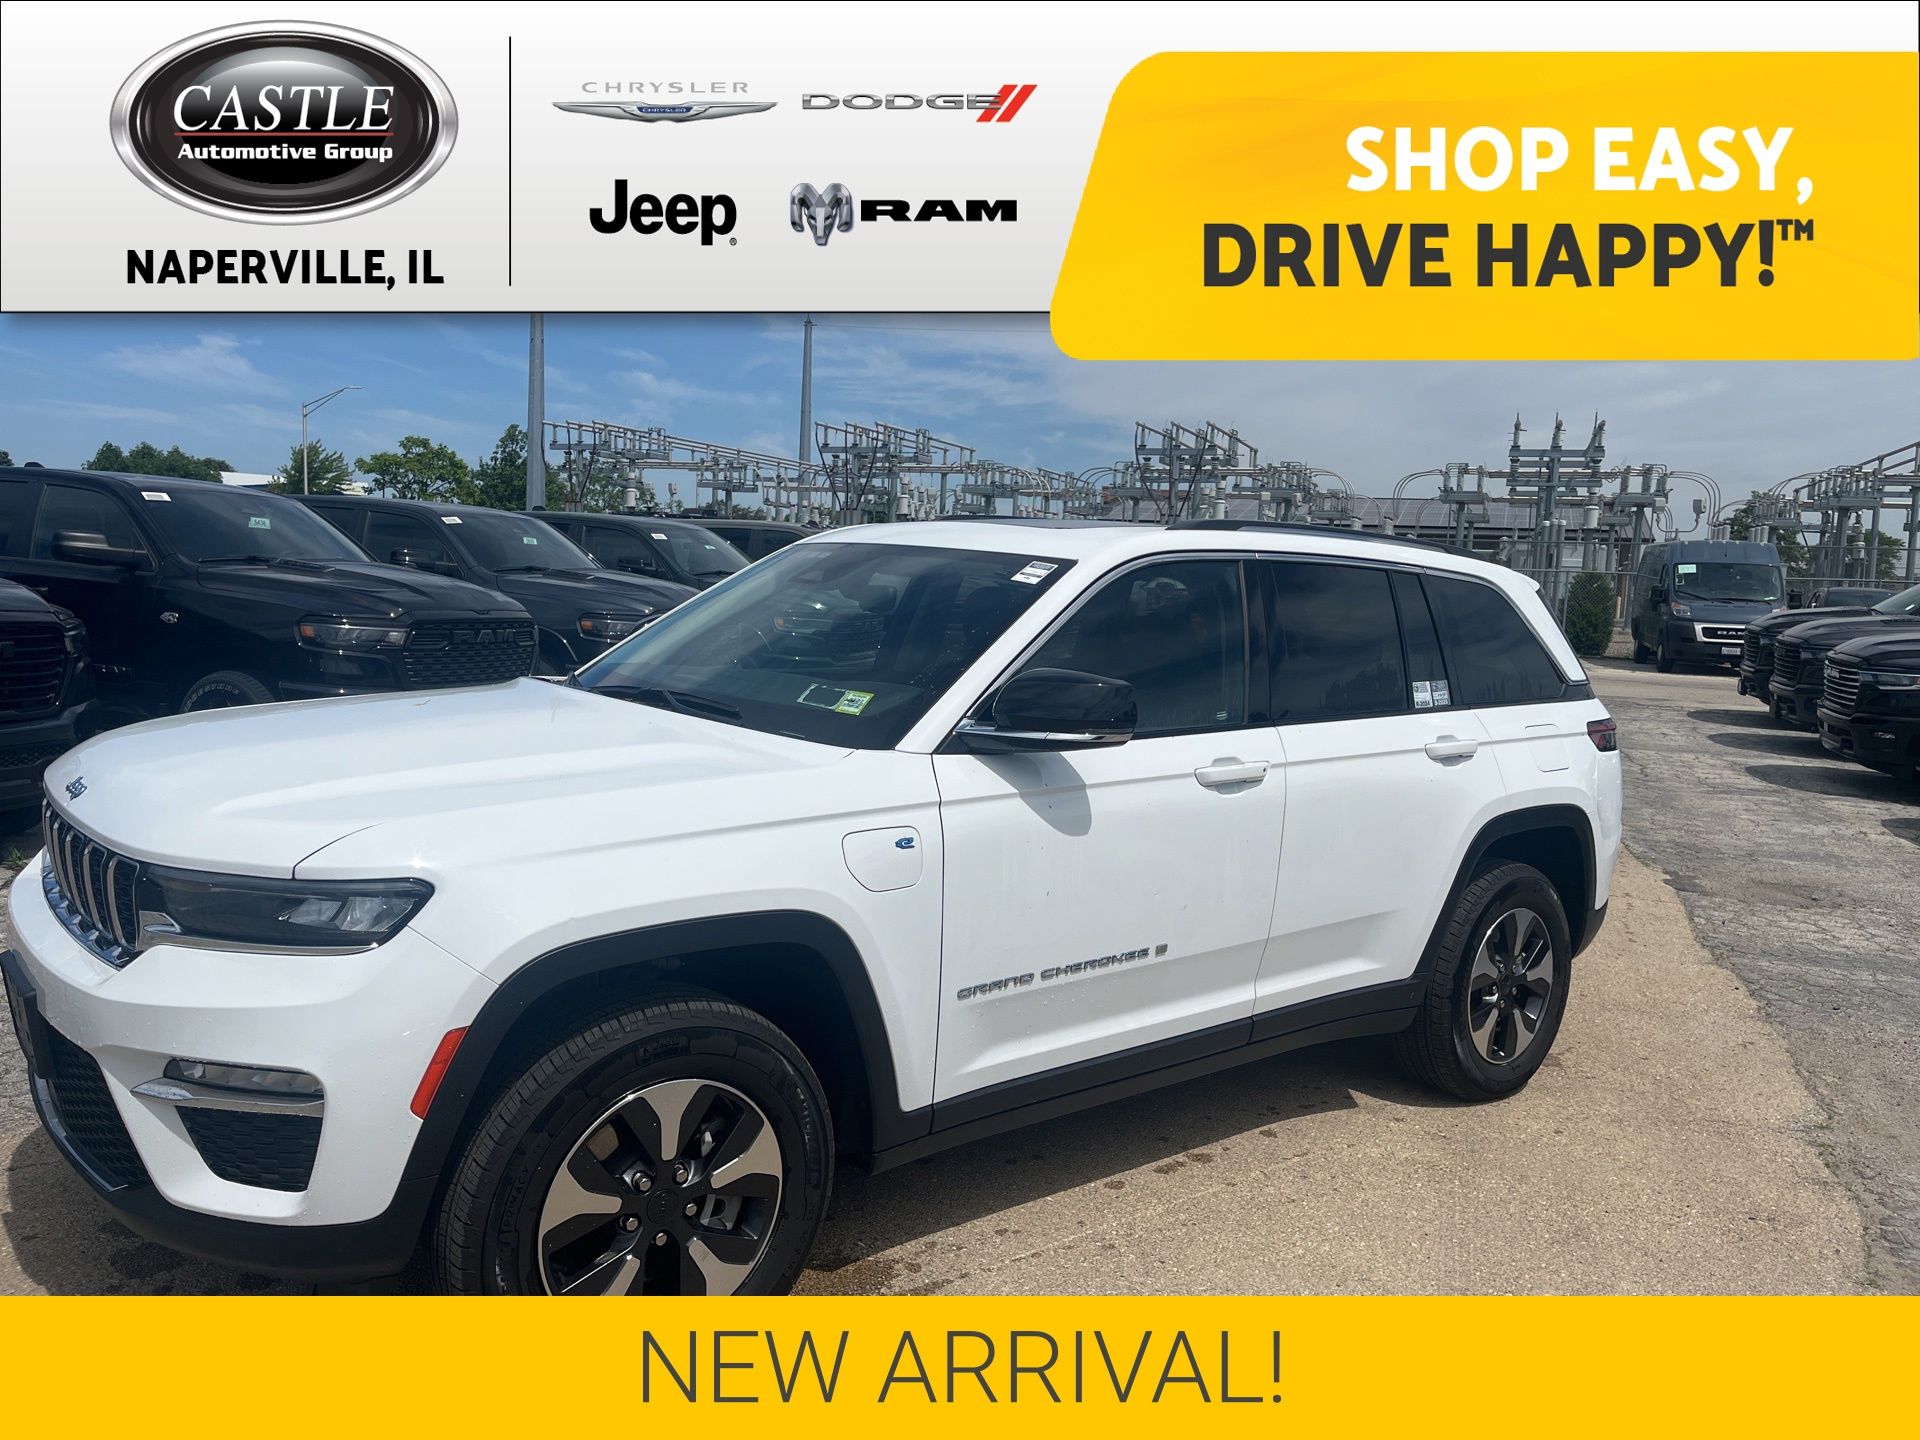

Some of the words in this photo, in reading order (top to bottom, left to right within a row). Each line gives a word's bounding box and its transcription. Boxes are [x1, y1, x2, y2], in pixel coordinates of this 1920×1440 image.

[449, 629, 515, 643] RAM
[957, 972, 1035, 1001] GRAND
[1040, 947, 1150, 982] CHEROKEE
